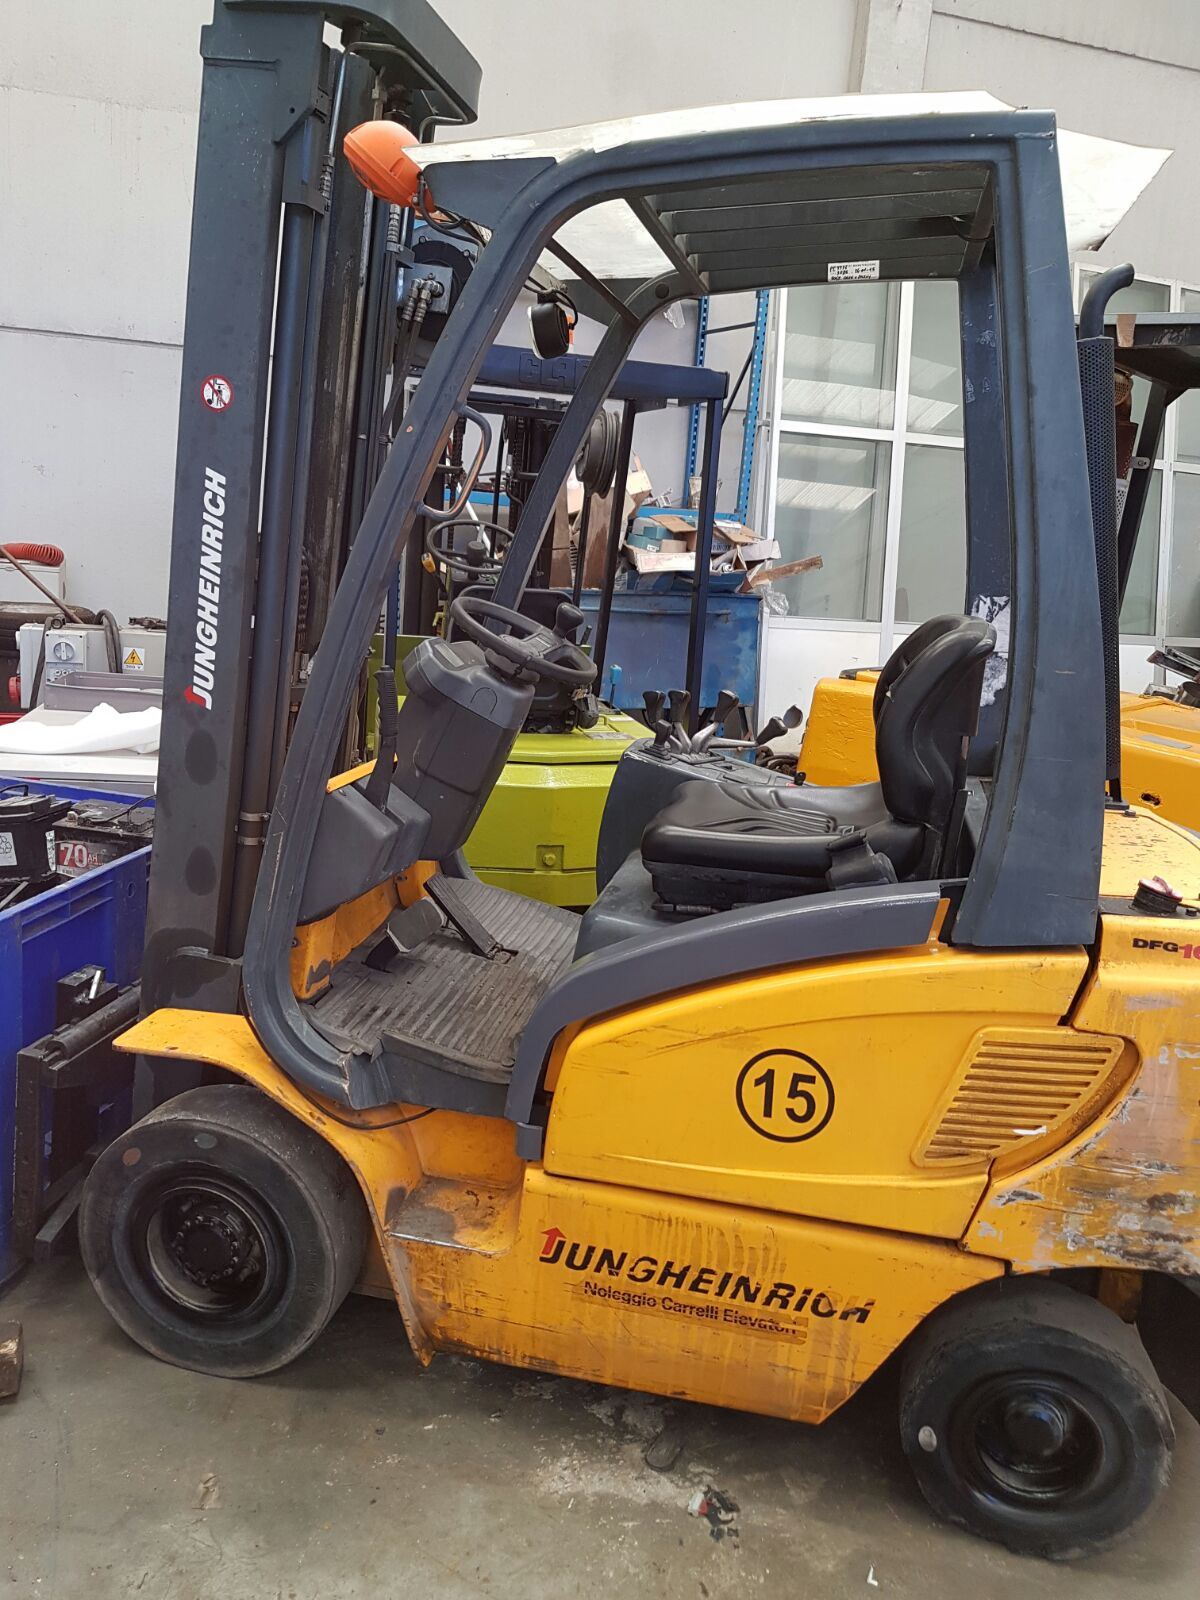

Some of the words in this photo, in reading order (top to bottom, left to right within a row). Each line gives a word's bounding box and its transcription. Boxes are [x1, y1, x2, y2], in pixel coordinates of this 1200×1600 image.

[191, 466, 227, 711] JUNGHEINRICH
[60, 842, 87, 868] 70
[754, 1068, 817, 1124] 15
[539, 1239, 876, 1324] JUNGHEINRICH
[584, 1280, 657, 1308] Noleggio
[661, 1295, 719, 1320] Carrelli
